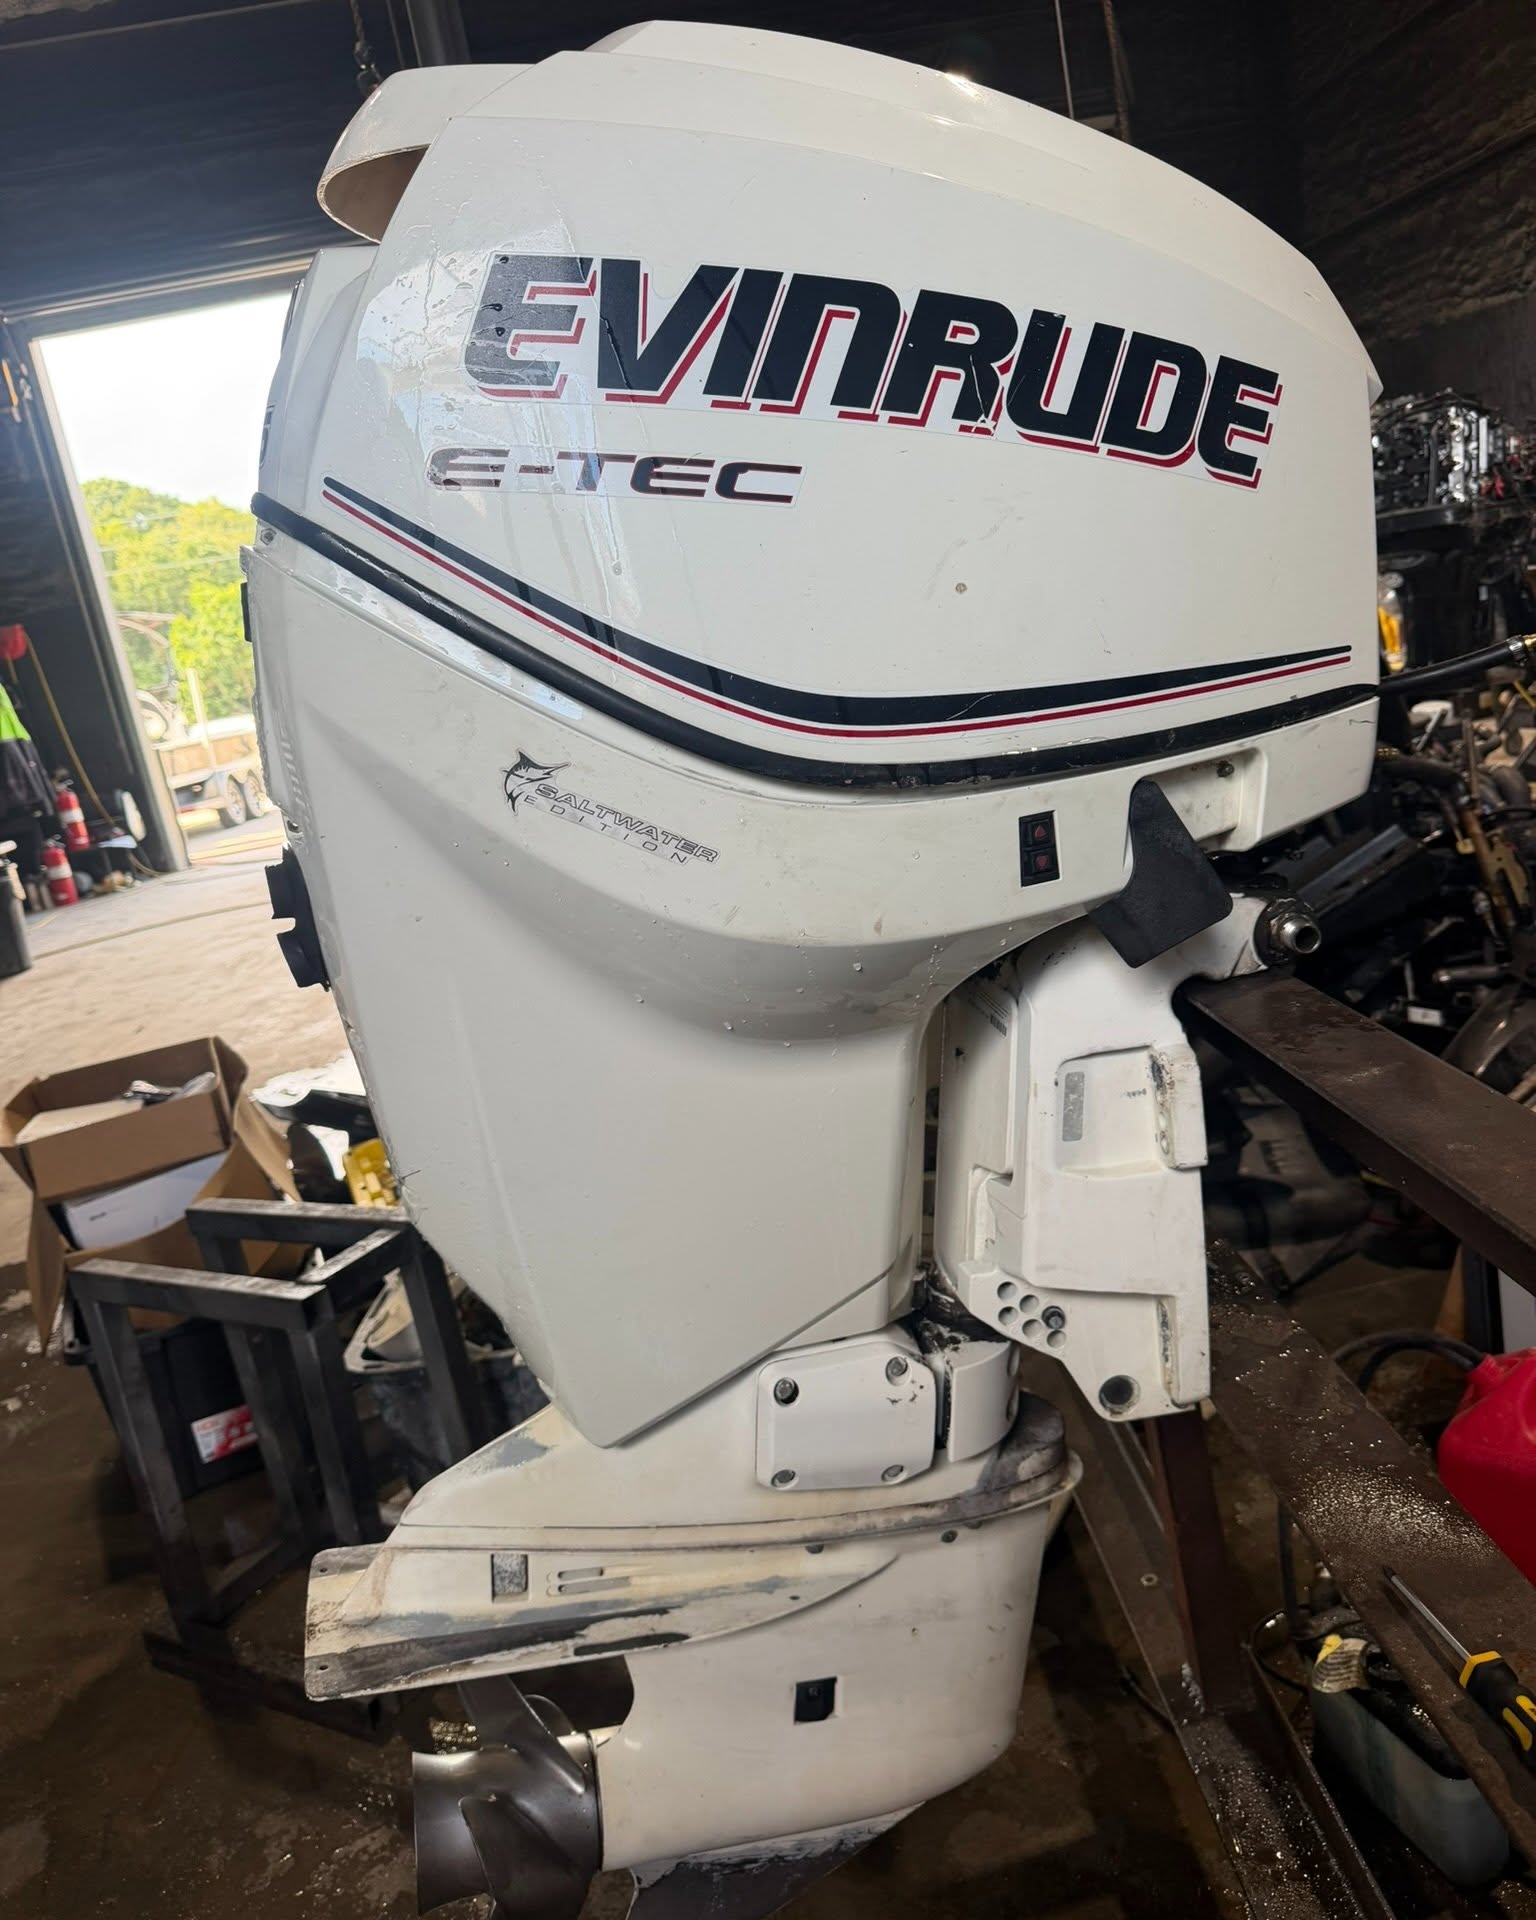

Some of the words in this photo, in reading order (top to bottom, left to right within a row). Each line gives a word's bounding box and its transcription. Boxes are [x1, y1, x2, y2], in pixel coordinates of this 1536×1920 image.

[463, 253, 1282, 490] EVINRUDE
[426, 446, 803, 504] E-TEC
[523, 794, 688, 864] EDITION
[535, 783, 719, 863] SALTWATER
